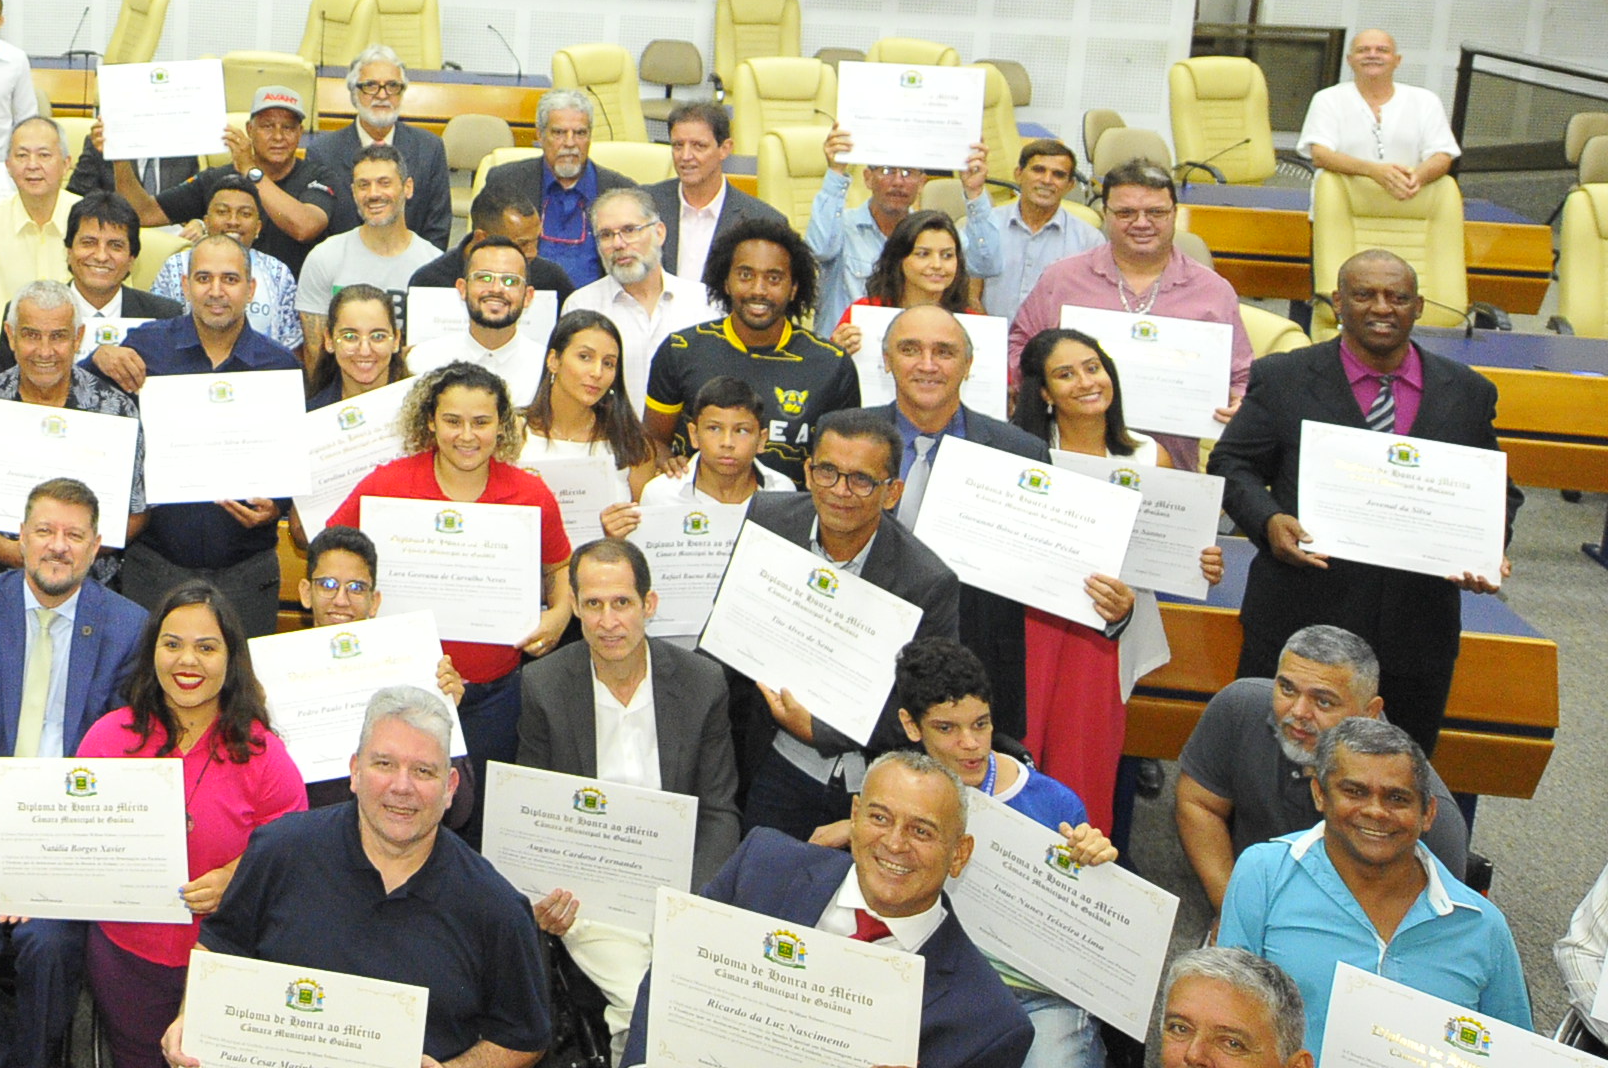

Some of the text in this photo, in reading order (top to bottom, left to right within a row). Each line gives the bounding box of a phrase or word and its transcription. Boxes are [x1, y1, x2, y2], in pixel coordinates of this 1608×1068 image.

[263, 93, 298, 104] AVANT
[17, 802, 55, 811] Diploma
[72, 802, 99, 811] Honra
[116, 802, 148, 812] Mérito
[520, 806, 560, 820] Diploma
[563, 814, 573, 822] de
[577, 816, 607, 829] Honra
[624, 826, 658, 838] Mérito
[71, 844, 97, 853] Borges
[101, 844, 125, 852] Xavier
[528, 844, 642, 869] Augusto Cardoso Fernandes
[990, 840, 1130, 925] Diploma de Honra ao Mérito
[1002, 860, 1030, 880] Câmara
[1032, 878, 1070, 903] Municipal
[1070, 900, 1078, 908] de
[994, 884, 1104, 950] Isaac Nunes Teixeira Lima
[698, 946, 874, 1006] Diploma de Honra ao Mérito
[714, 968, 852, 1015] Câmara Municipal de Goiânia
[224, 1005, 381, 1040] Diploma de Honra ao Mérito
[240, 1022, 272, 1035] Câmara
[274, 1028, 316, 1042] Municipal
[318, 1036, 326, 1044] de
[706, 998, 850, 1049] Ricardo da Luz Nascimento
[220, 1050, 276, 1068] Paulo Cesar
